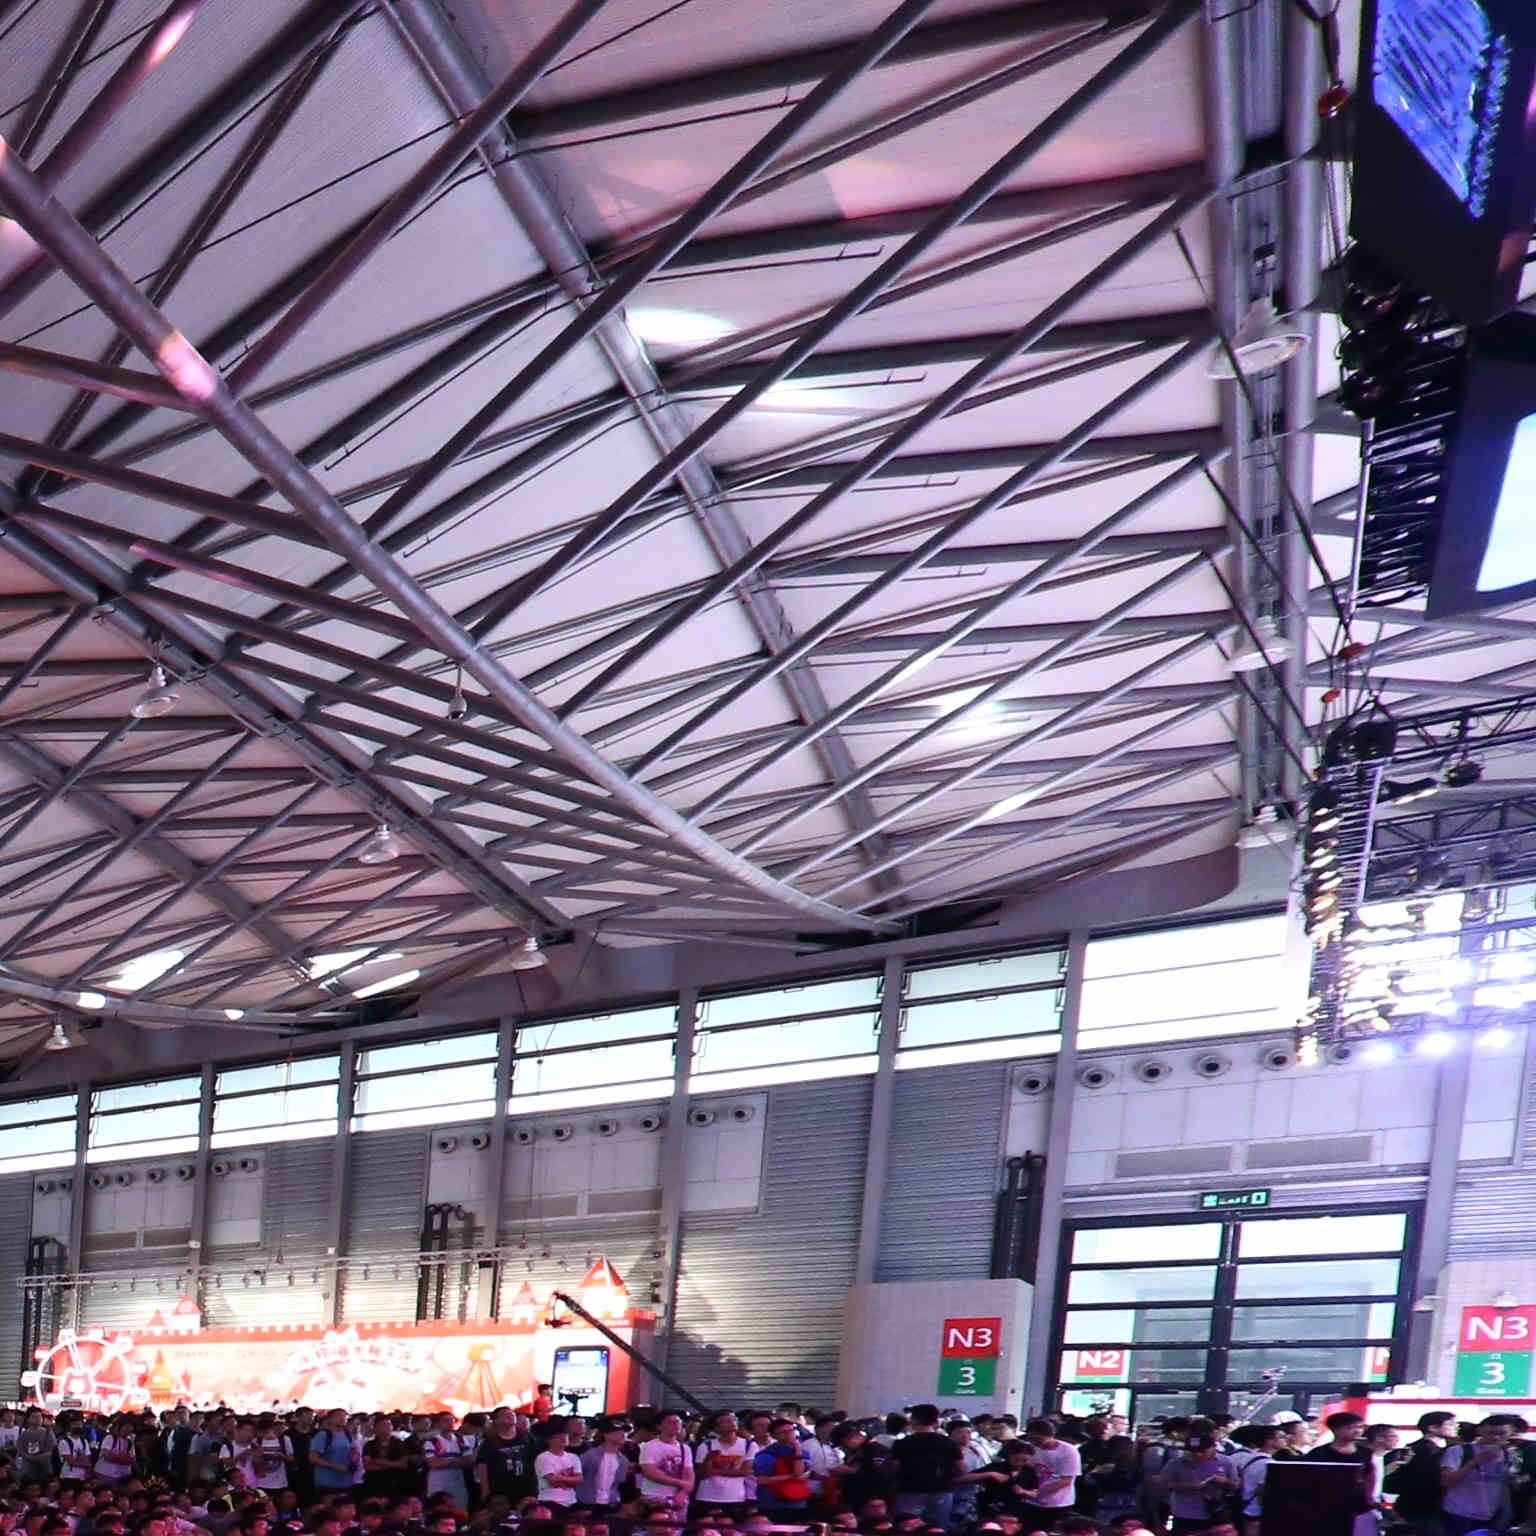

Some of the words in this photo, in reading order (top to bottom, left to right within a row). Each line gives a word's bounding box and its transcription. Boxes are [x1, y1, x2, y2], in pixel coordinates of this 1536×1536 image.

[948, 1328, 993, 1348] N3
[1466, 1316, 1529, 1341] N3
[1079, 1351, 1121, 1369] N2
[957, 1366, 976, 1386] 3
[1479, 1361, 1505, 1385] 3
